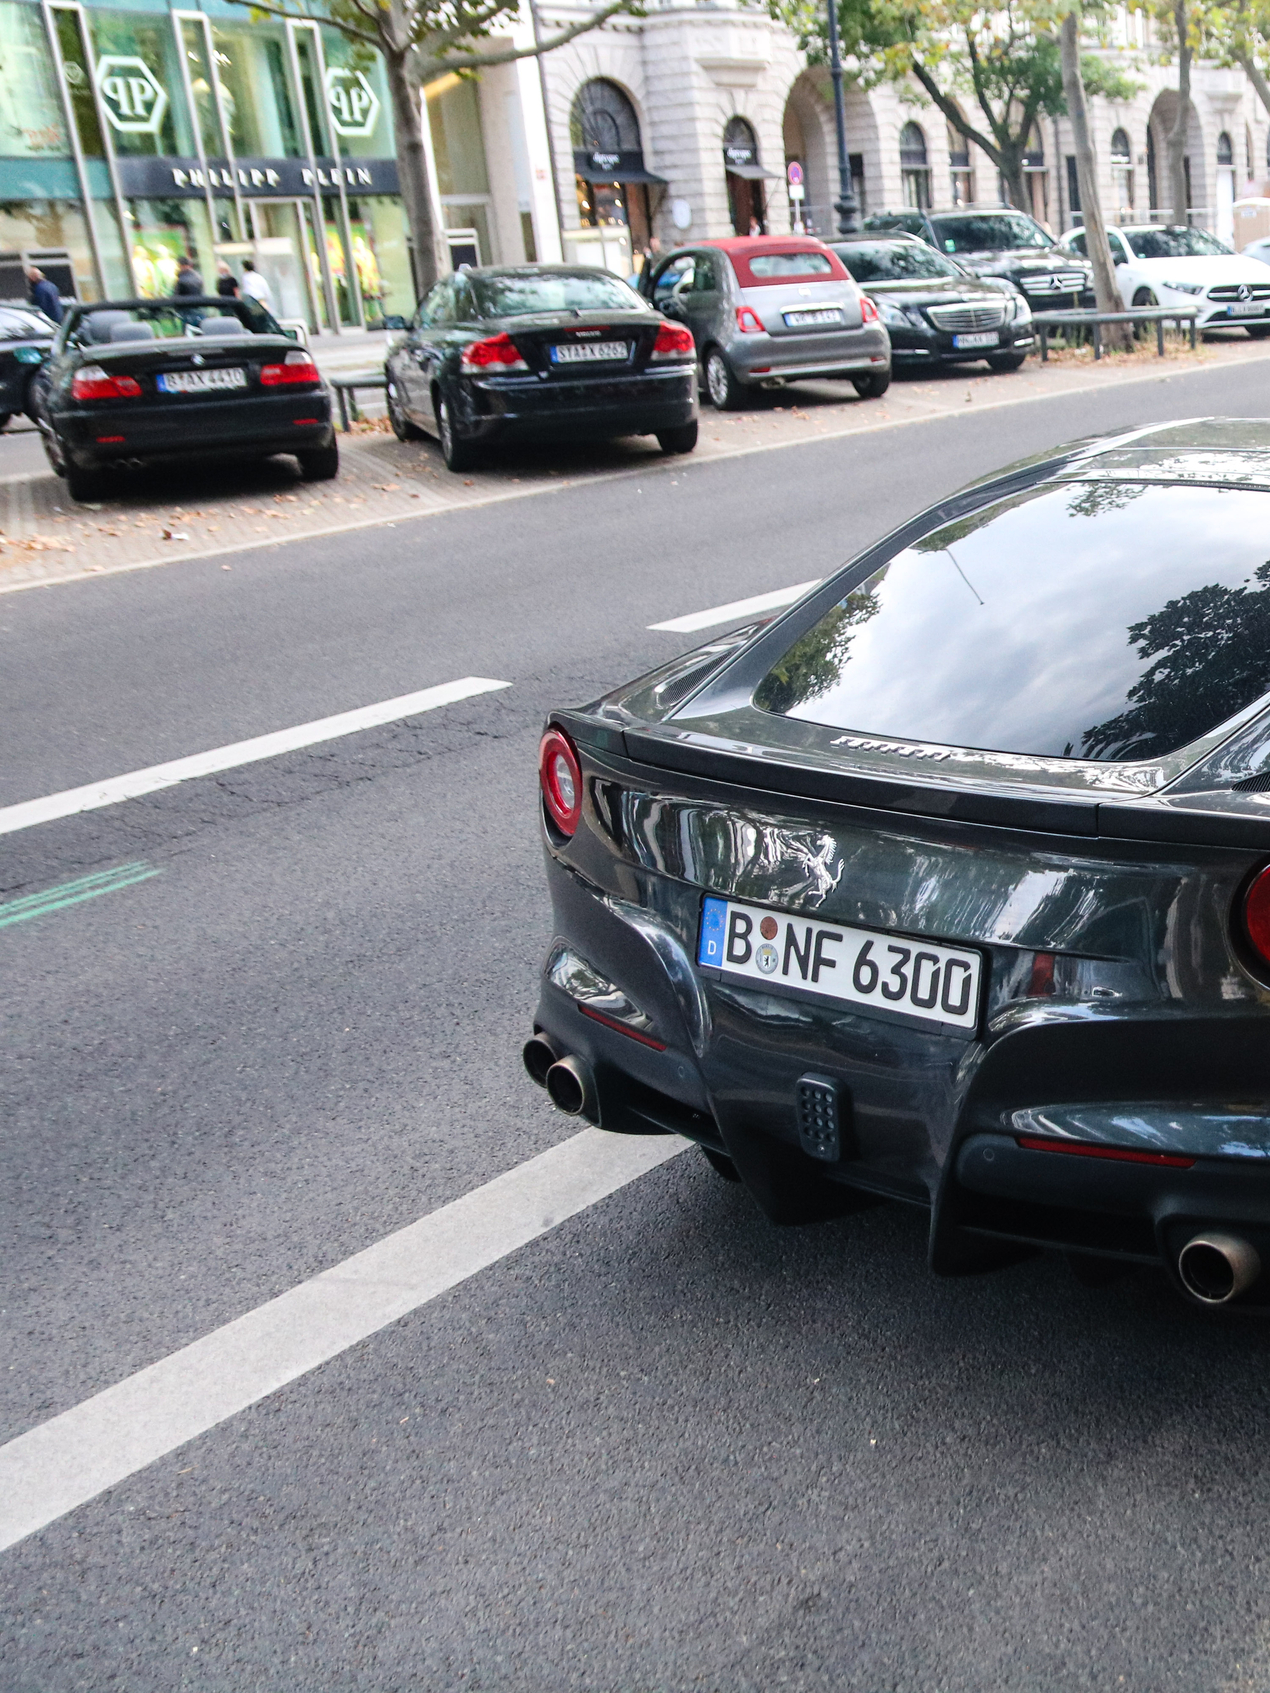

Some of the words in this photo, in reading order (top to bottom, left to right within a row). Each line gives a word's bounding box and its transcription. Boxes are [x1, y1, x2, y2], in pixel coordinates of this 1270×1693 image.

[172, 167, 280, 188] PHILIPP
[301, 167, 373, 186] PLEIN
[707, 940, 717, 955] D
[726, 910, 753, 964] B
[782, 922, 844, 983] NF
[852, 940, 973, 1016] 6300
